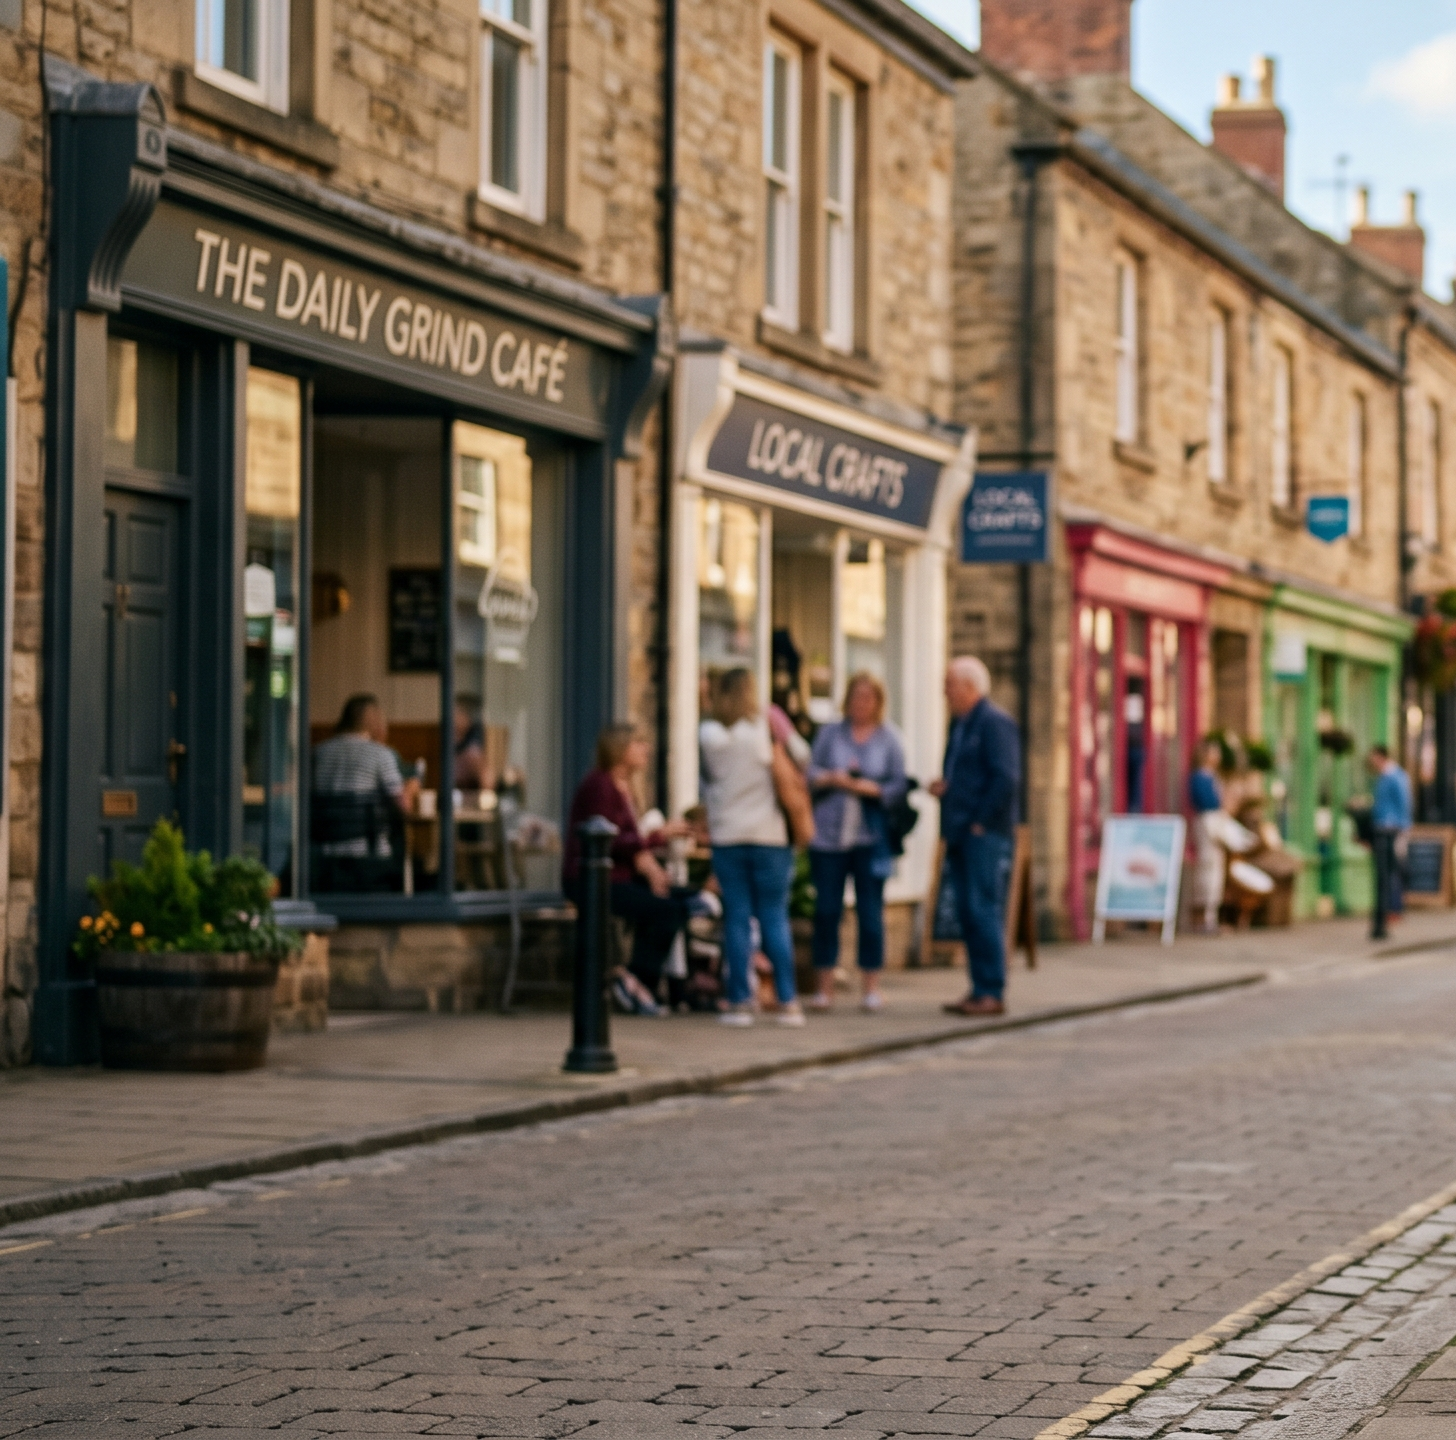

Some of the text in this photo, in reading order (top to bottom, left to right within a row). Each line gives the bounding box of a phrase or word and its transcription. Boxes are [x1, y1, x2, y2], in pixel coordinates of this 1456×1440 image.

[194, 228, 569, 403] THE DAILY GRIND CAFÉ
[747, 418, 909, 510] LOCAL CRAFTS
